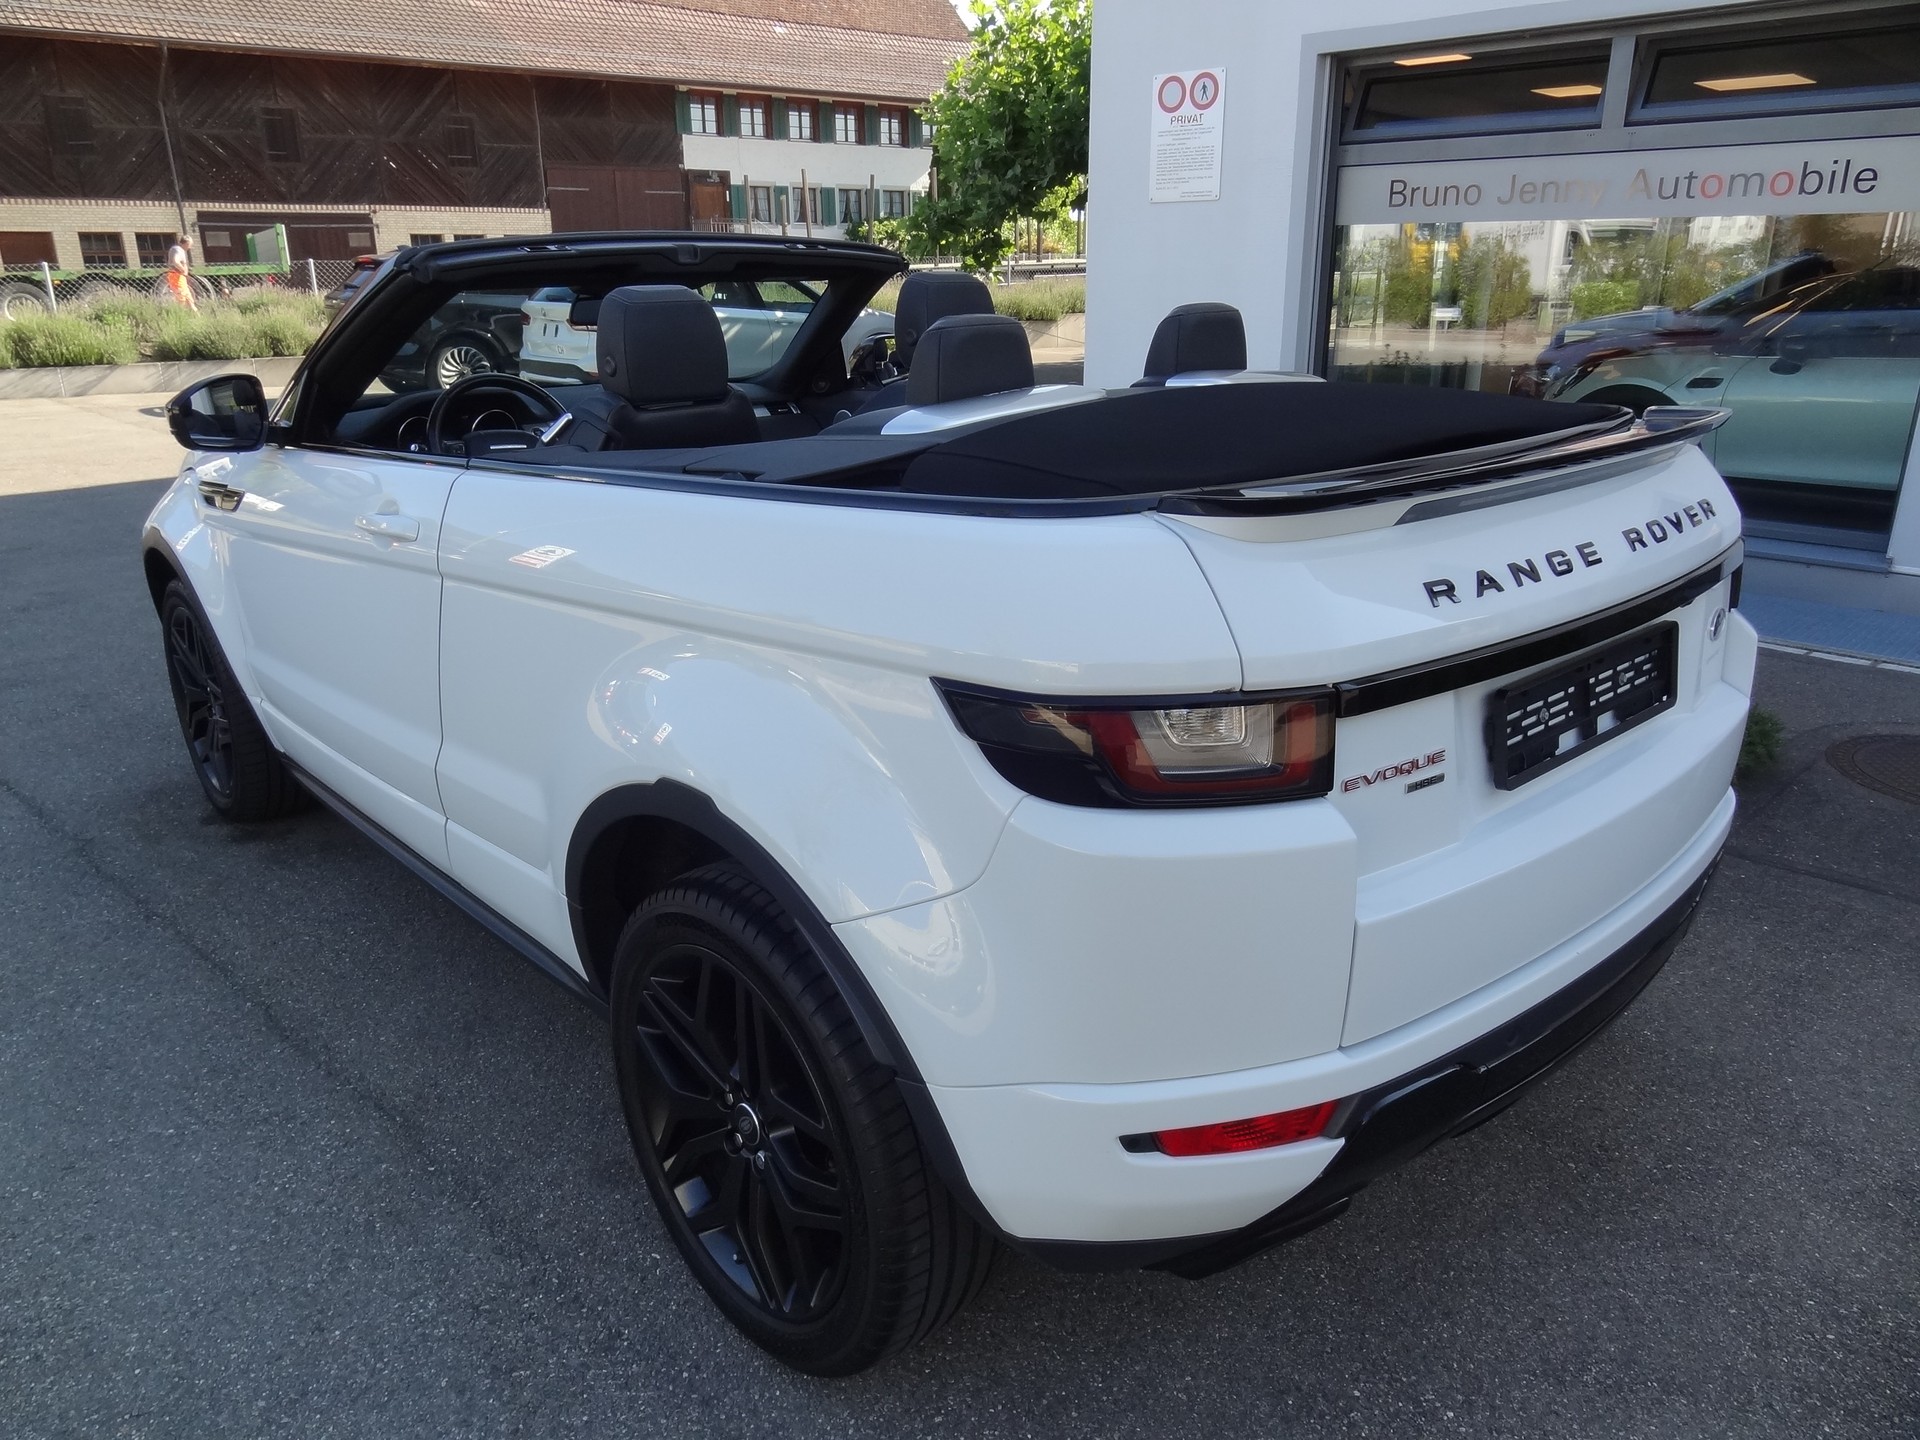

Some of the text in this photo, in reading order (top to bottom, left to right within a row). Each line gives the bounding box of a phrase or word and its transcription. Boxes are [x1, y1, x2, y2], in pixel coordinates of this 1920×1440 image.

[1170, 113, 1204, 125] PRIVAT
[1388, 159, 1879, 209] Bruno Jenny Automobile
[1422, 498, 1718, 608] RANGE ROVER
[1341, 748, 1446, 793] EVOQUE
[1415, 775, 1438, 790] HSE
